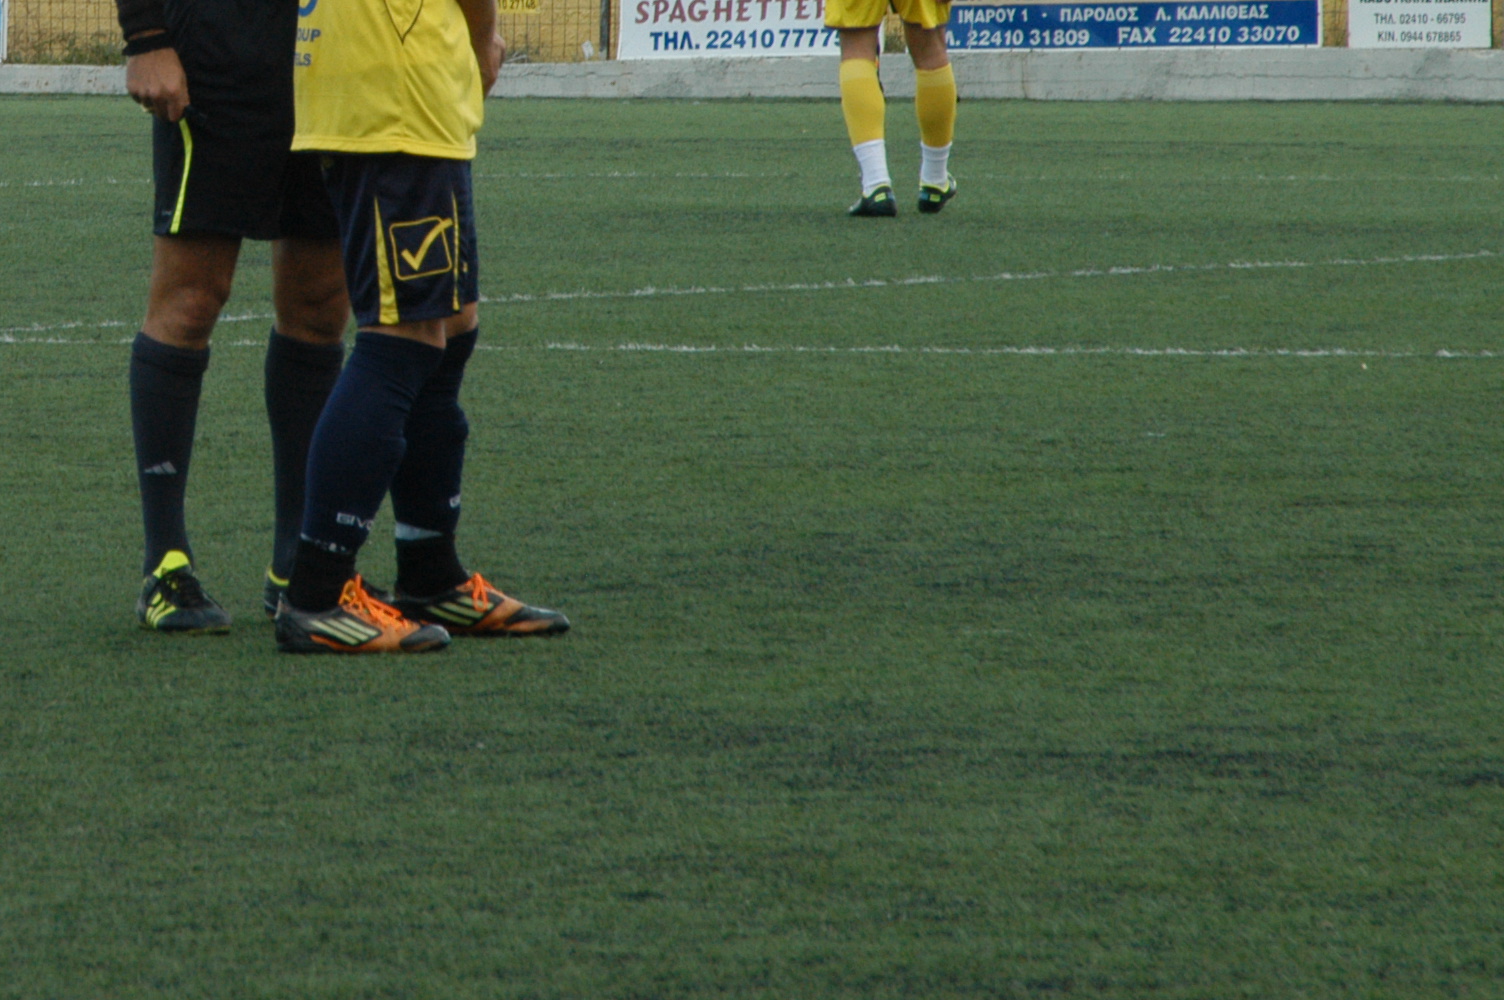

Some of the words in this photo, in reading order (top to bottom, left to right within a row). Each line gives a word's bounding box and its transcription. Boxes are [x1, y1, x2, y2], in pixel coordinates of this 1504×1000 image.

[1021, 8, 1029, 23] 1
[1060, 6, 1139, 22] ΠΑΡΟΔΟΣ
[1155, 6, 1172, 22] Λ.
[1176, 4, 1269, 21] ΚΑΛΛΙΘΕΑΣ
[1374, 13, 1396, 24] ΤΗΛ.
[1399, 13, 1428, 24] 02410
[650, 31, 700, 51] ΤΗΛ.
[706, 29, 774, 49] 22410
[945, 30, 961, 47] Λ.
[967, 29, 1023, 47] 22410
[1029, 29, 1090, 47] 31809
[1118, 26, 1156, 44] FAX
[1169, 26, 1231, 44] 22410
[1237, 25, 1300, 43] 33070
[1377, 31, 1398, 42] ΚΙΝ.
[1401, 31, 1424, 42] 0944
[336, 512, 375, 531] GIVO
